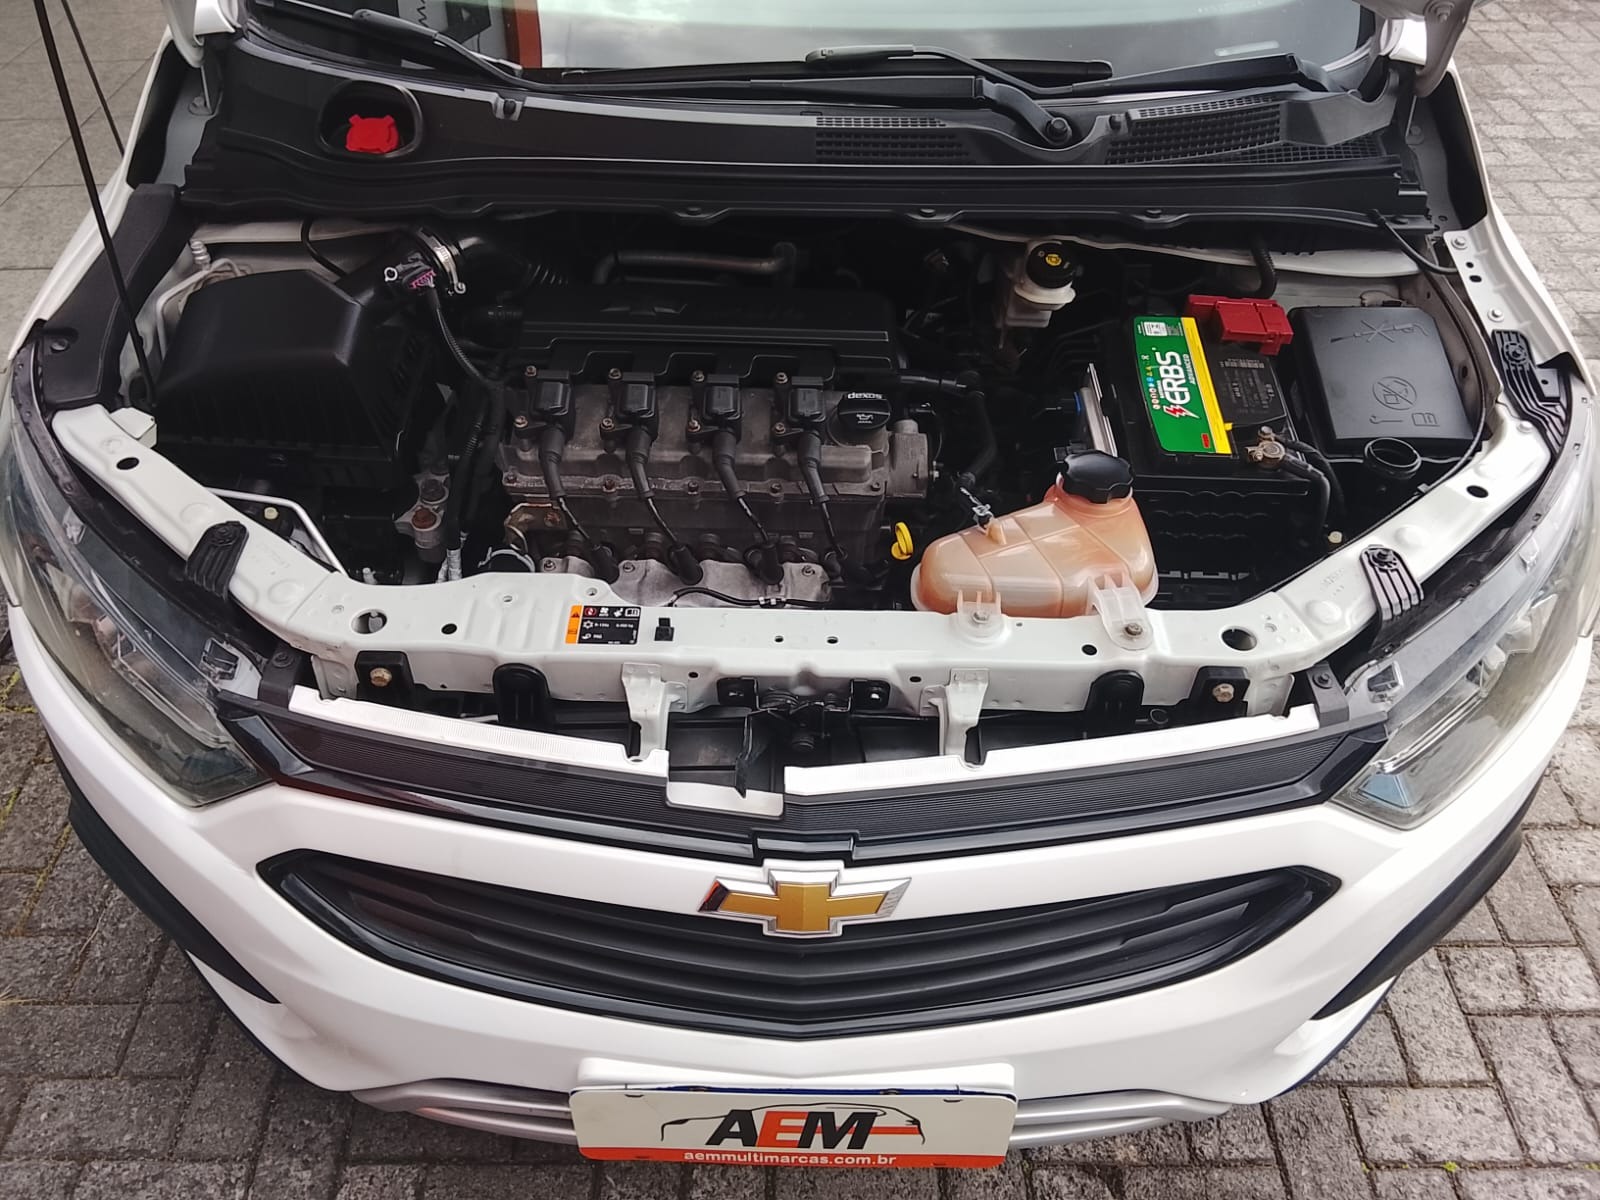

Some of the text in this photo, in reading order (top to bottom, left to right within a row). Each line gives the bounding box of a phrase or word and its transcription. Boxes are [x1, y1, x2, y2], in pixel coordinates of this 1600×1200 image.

[1155, 351, 1191, 405] ERBS
[705, 1109, 877, 1149] AEM
[684, 1150, 896, 1165] aemmultimarcas.com.br
